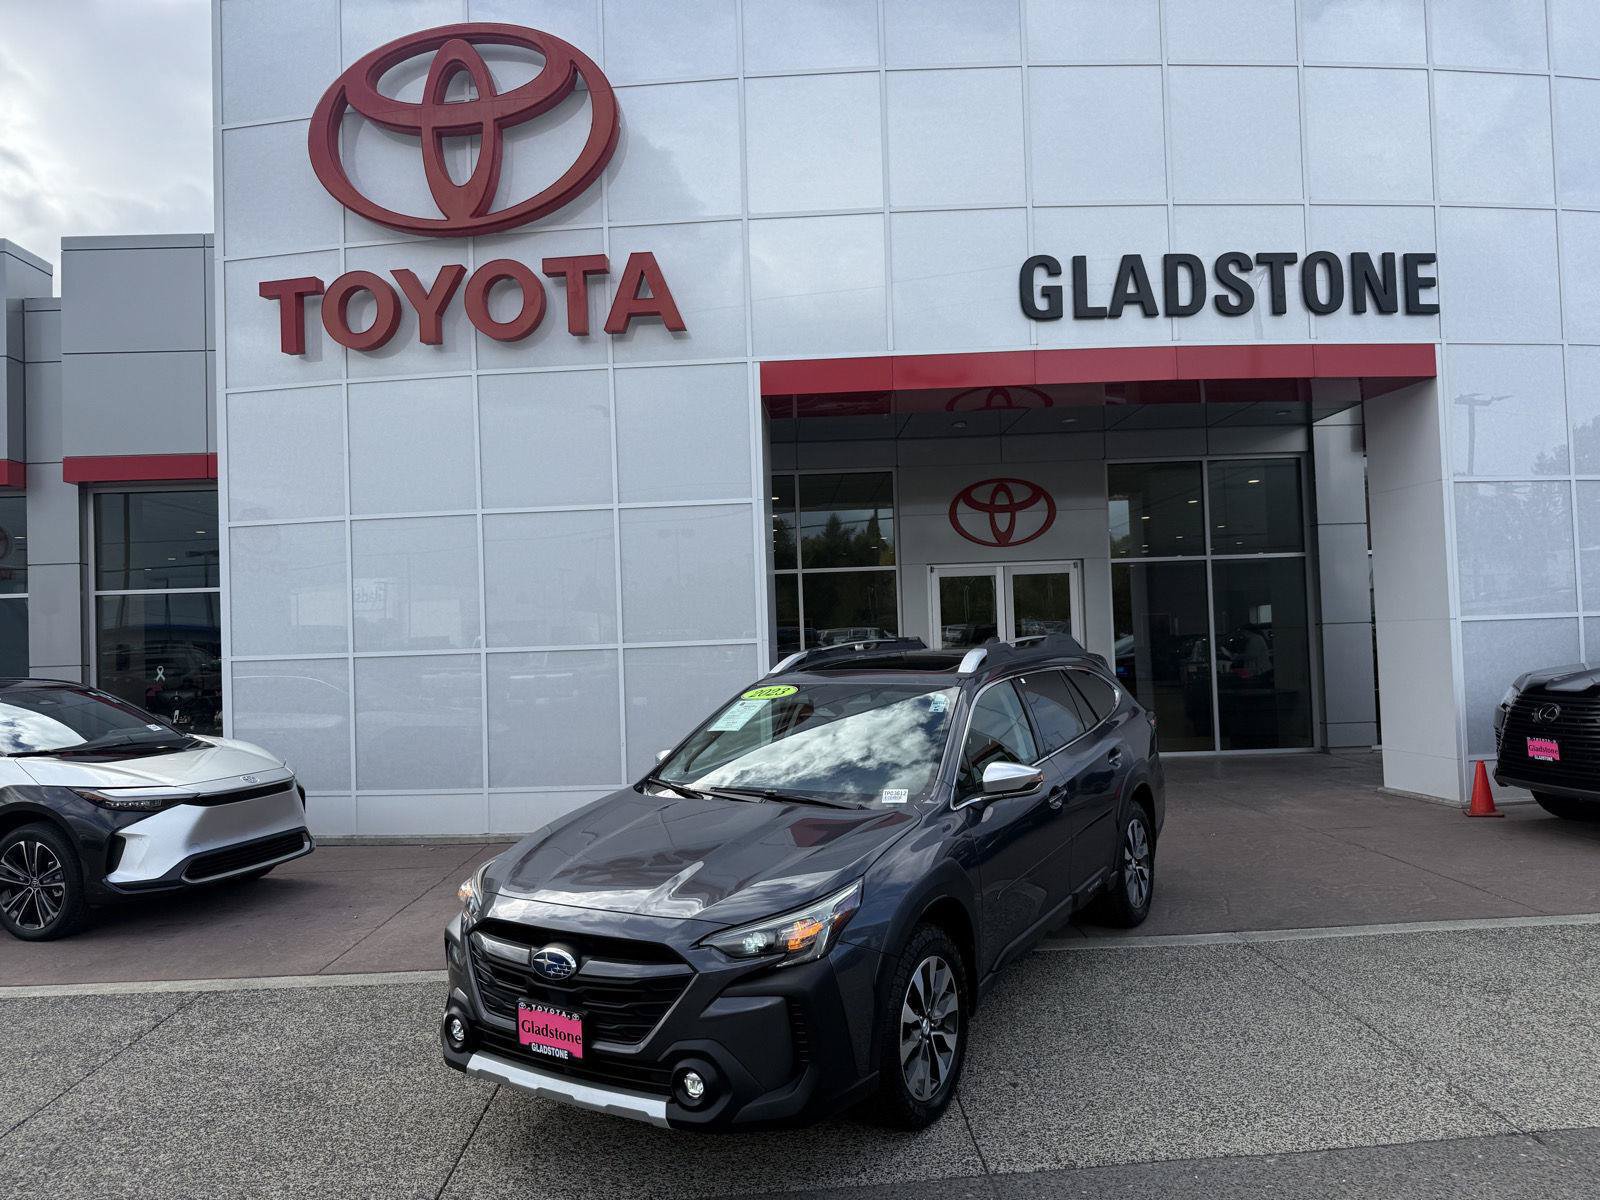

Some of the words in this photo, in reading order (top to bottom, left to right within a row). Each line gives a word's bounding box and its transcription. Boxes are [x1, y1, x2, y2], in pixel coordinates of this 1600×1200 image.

[1019, 251, 1440, 320] GLADSTONE
[259, 251, 687, 355] TOYOTA
[749, 688, 791, 698] 2023
[531, 1004, 567, 1018] TOYOTA
[521, 1020, 581, 1044] Gladstone
[531, 1043, 568, 1059] GLADSTONE
